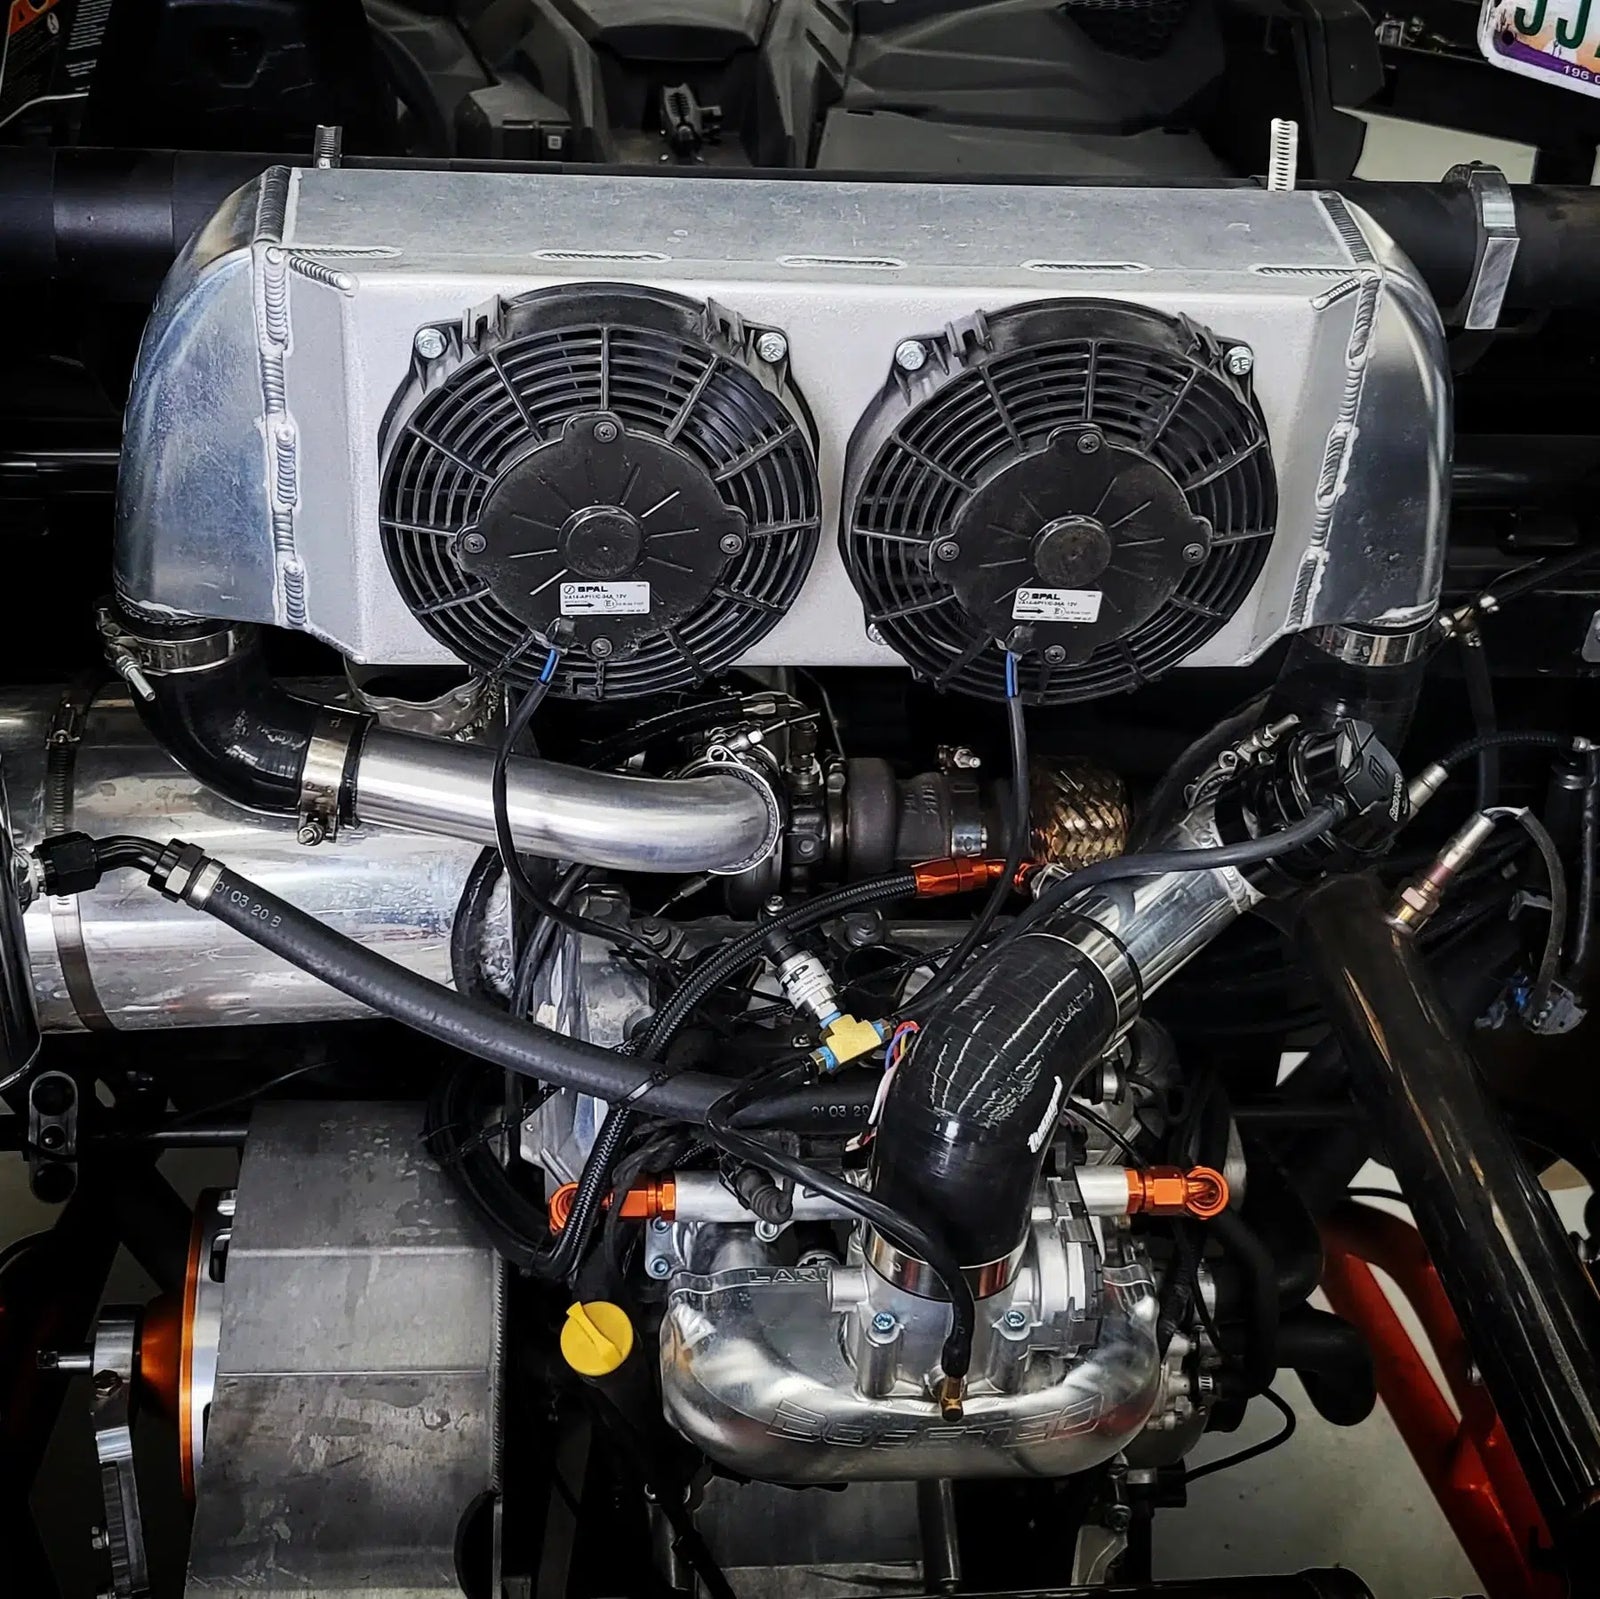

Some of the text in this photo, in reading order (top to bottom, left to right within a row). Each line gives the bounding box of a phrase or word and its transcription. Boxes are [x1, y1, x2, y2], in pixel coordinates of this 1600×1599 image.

[1563, 65, 1589, 80] 196
[230, 891, 250, 908] 03
[250, 904, 269, 920] 20
[828, 1105, 847, 1117] 03
